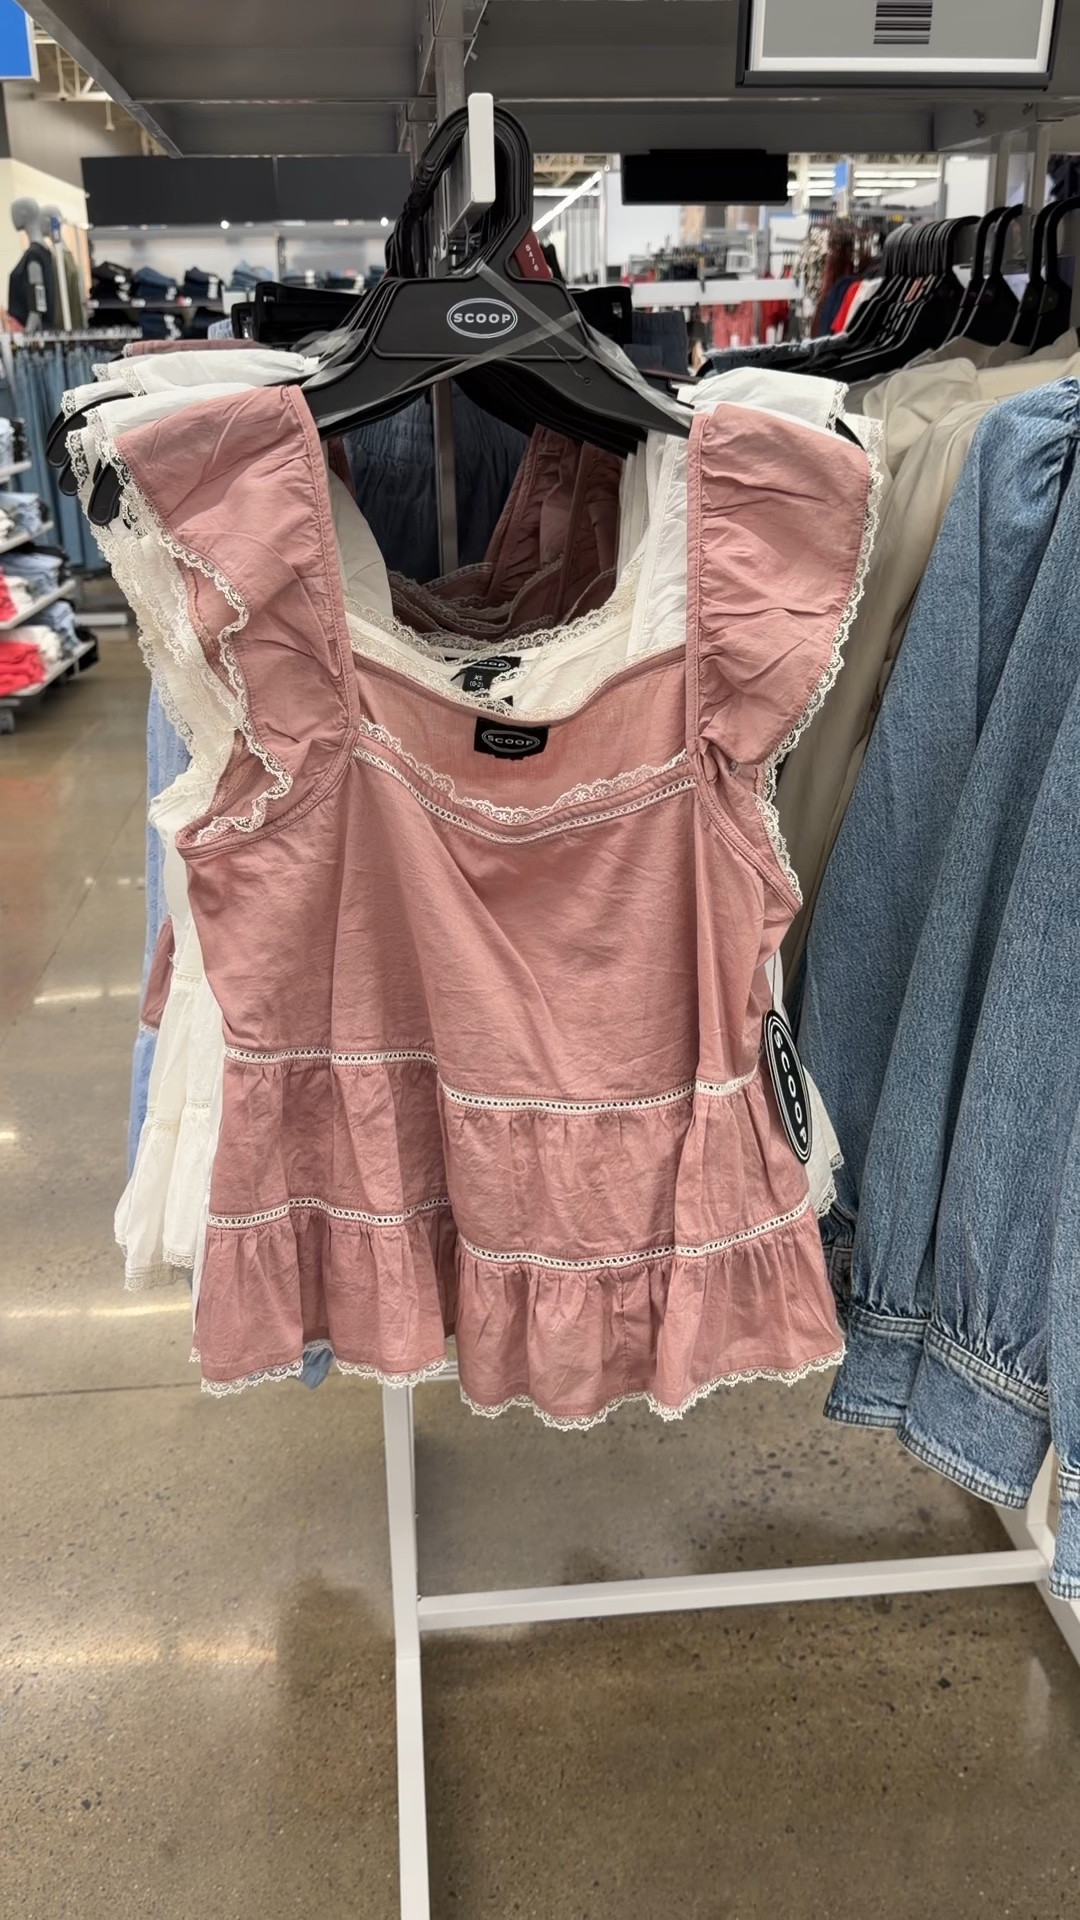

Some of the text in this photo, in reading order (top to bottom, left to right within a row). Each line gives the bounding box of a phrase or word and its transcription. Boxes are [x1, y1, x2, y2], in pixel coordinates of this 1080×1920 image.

[453, 312, 512, 324] SCOOP
[487, 734, 534, 746] SCOOP
[773, 1031, 808, 1145] SCOOP
